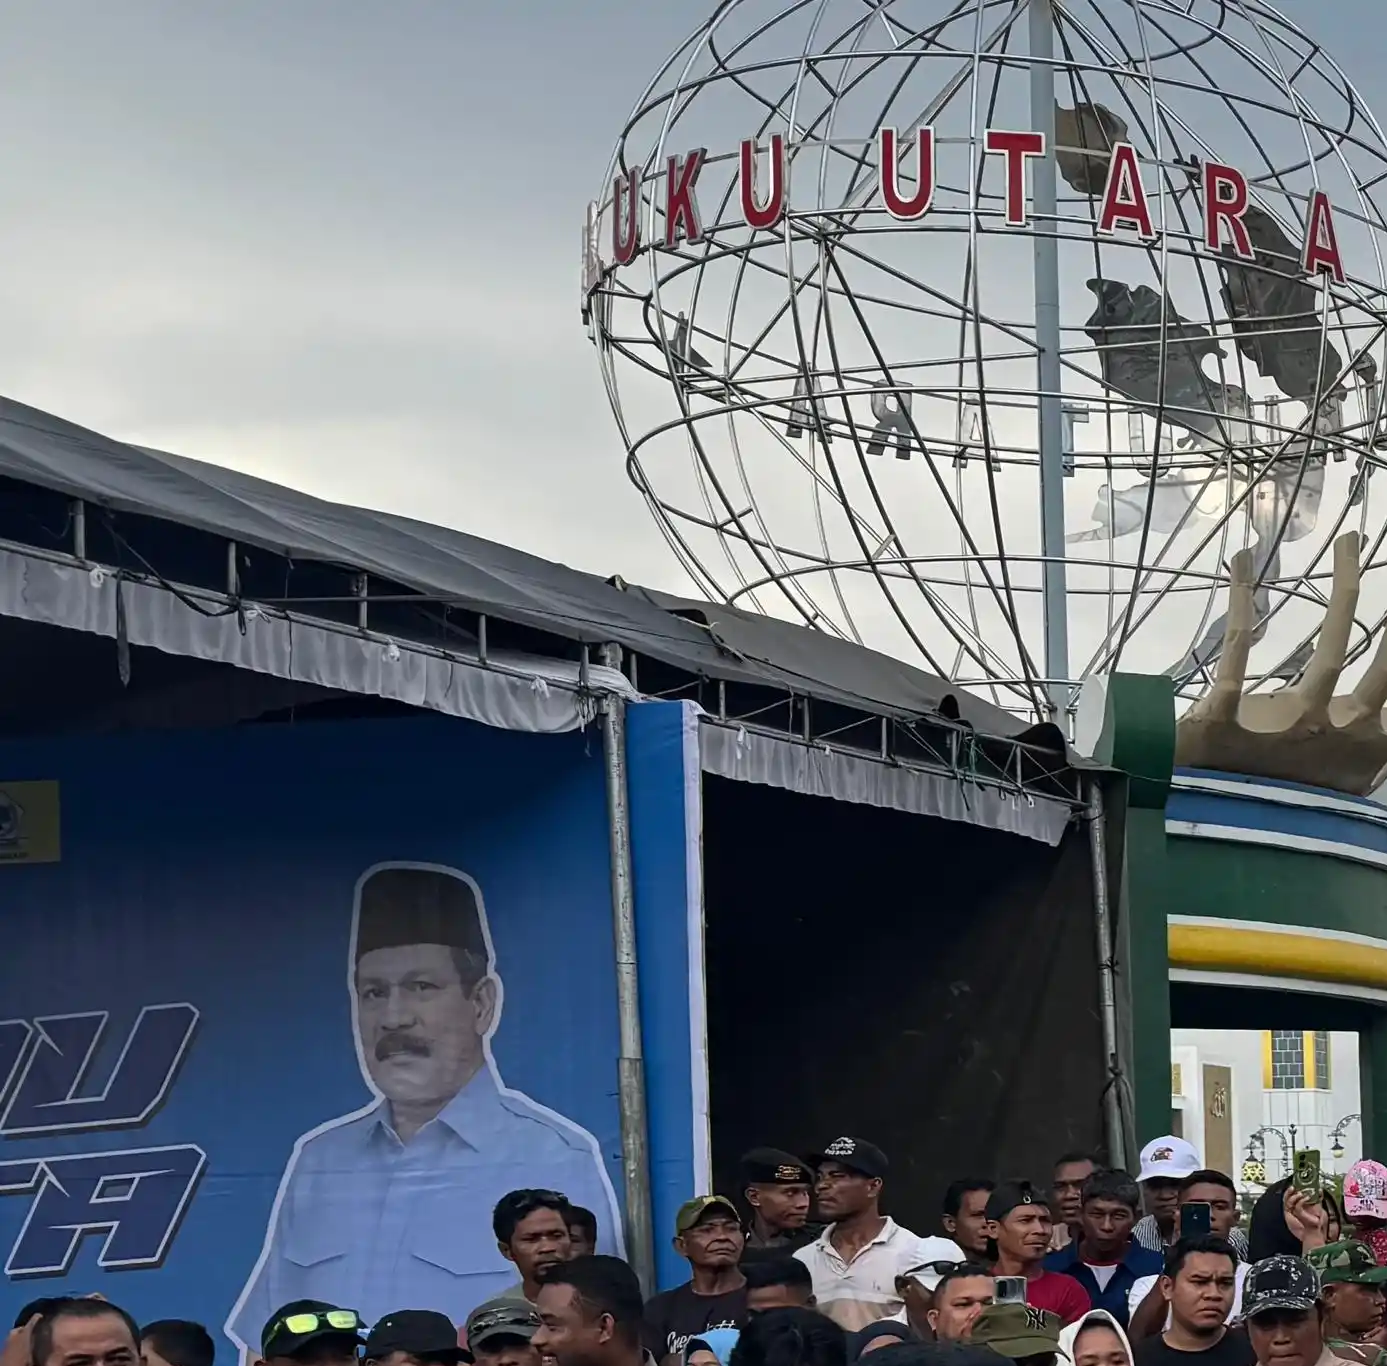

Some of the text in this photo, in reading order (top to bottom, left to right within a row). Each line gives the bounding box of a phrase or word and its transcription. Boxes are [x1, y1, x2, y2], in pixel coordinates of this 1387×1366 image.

[590, 126, 1348, 287] UKU UTARA
[0, 1002, 200, 1136] U
